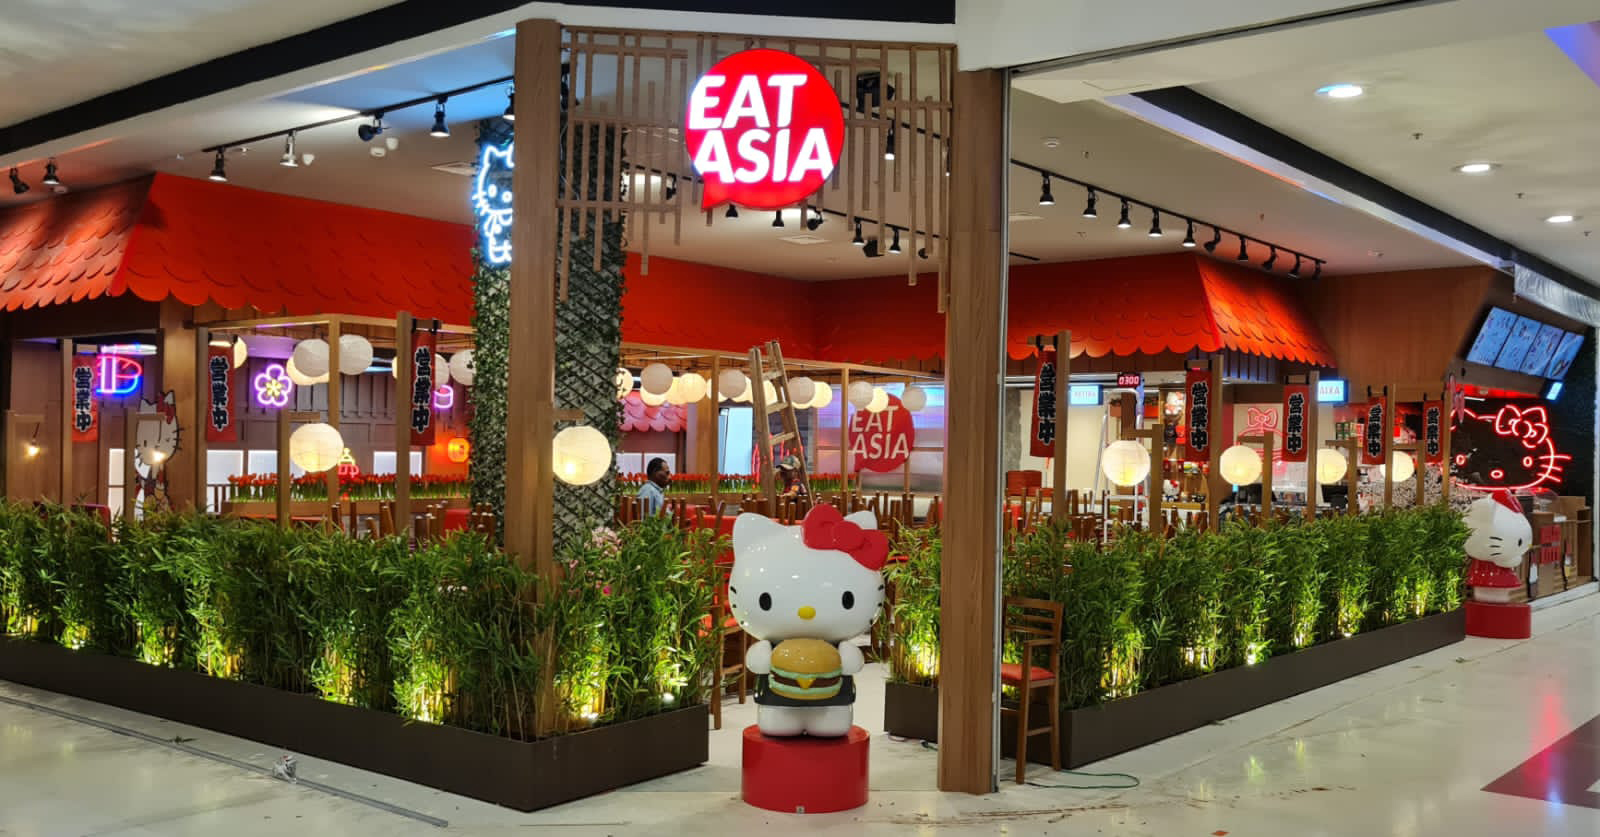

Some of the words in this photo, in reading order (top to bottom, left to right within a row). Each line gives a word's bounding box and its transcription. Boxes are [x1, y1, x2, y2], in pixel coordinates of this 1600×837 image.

[689, 74, 807, 130] EAT
[693, 127, 834, 183] ASIA
[74, 366, 94, 433] 営業中
[209, 355, 229, 432] 営業中
[411, 347, 431, 433] 営業中
[852, 405, 899, 433] EAT
[1190, 381, 1209, 451] 営業中
[853, 433, 909, 460] ASIA
[1287, 392, 1304, 453] 営業中
